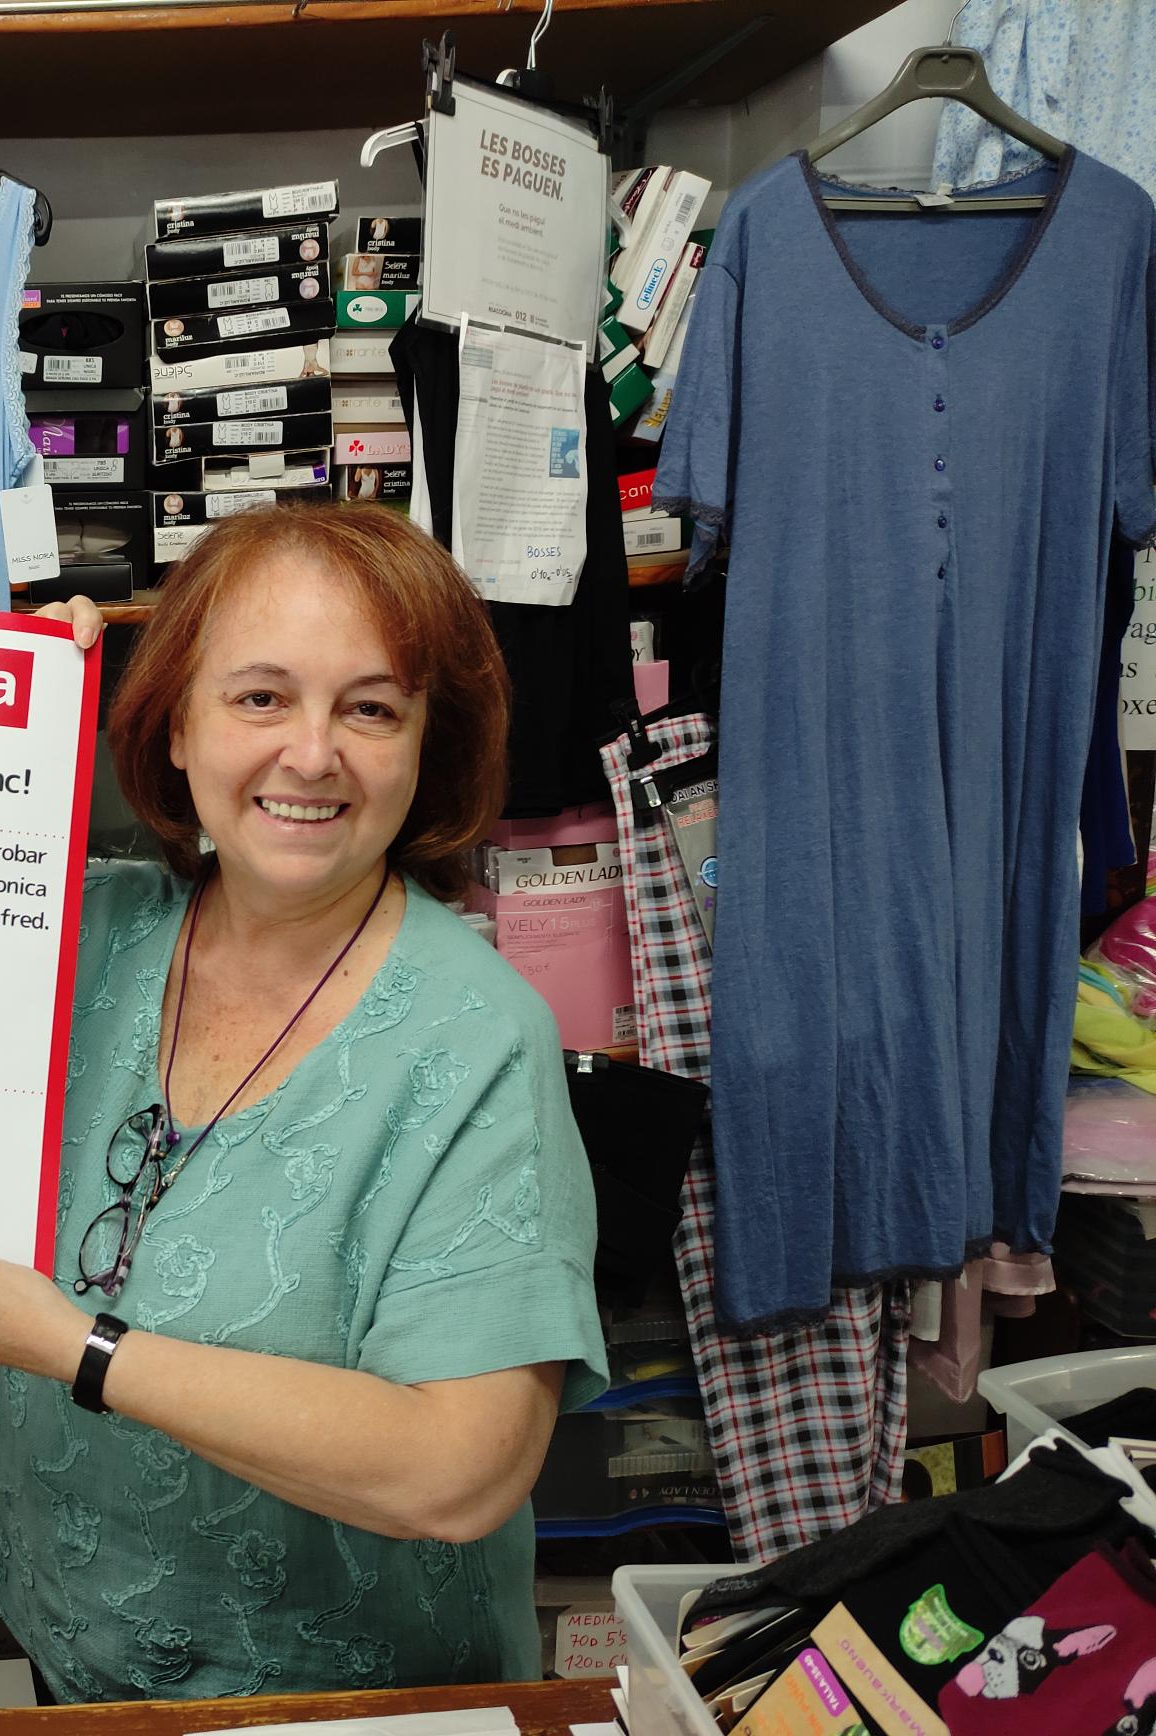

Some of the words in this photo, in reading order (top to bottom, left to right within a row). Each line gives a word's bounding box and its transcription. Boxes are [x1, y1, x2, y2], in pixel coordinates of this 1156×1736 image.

[480, 129, 509, 156] LES
[511, 140, 567, 177] BOSSES
[480, 156, 500, 180] ES
[502, 163, 564, 202] PAGUEN.
[367, 239, 396, 247] cristina
[526, 545, 563, 558] BOSSES
[516, 869, 585, 889] GOLDEN
[523, 898, 562, 907] GOLDEN
[563, 896, 587, 905] LADY
[0, 907, 50, 930] fred.
[507, 918, 548, 932] VELY
